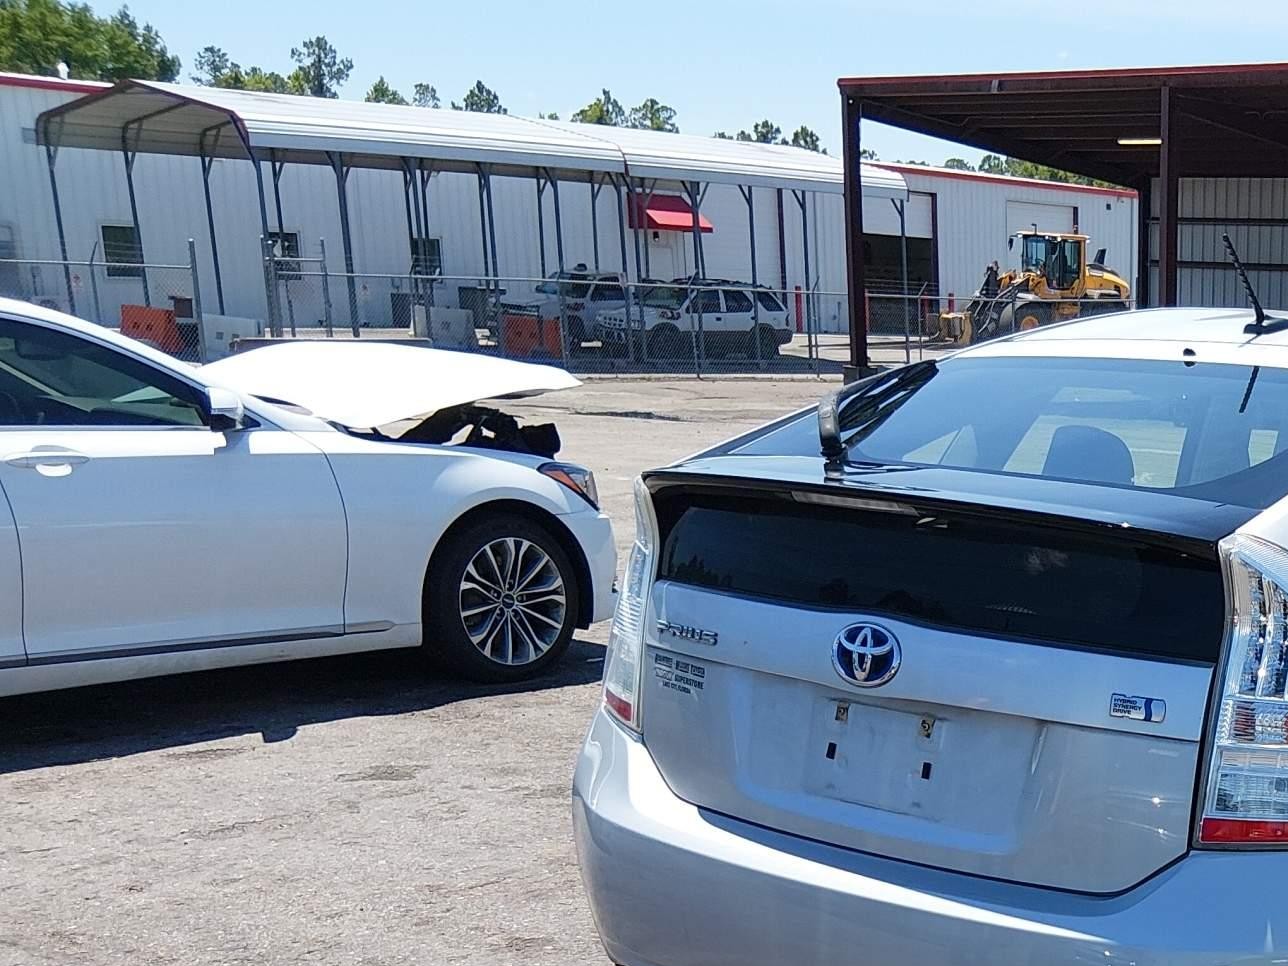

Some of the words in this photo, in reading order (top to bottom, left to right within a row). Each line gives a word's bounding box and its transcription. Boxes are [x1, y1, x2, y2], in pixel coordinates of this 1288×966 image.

[656, 619, 719, 647] PRIUS
[674, 673, 705, 690] SUPERSTORE
[1112, 702, 1142, 711] SYNERGY
